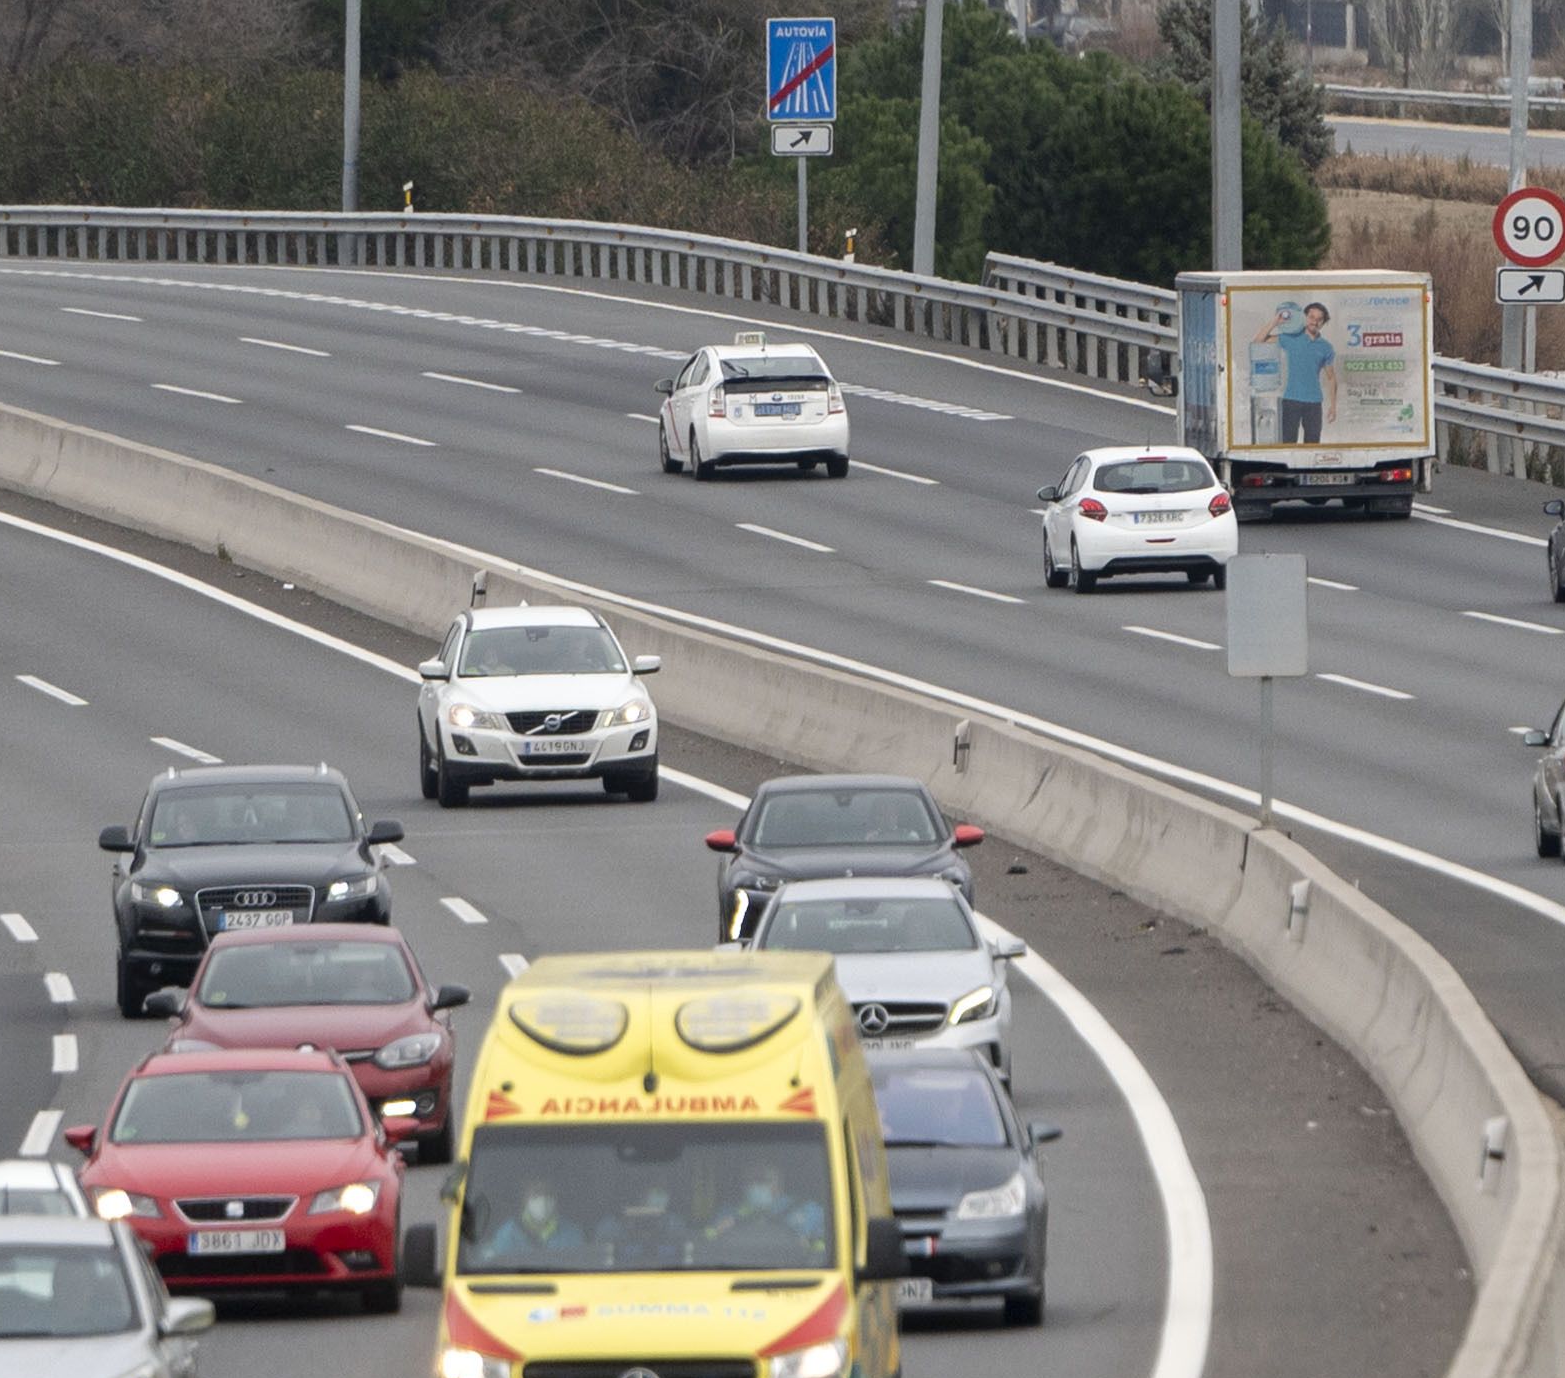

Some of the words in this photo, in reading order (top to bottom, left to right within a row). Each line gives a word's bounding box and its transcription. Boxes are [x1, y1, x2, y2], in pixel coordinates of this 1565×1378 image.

[775, 24, 828, 39] AUTOVÍA
[1512, 214, 1554, 243] 90
[1346, 324, 1362, 347] 3
[1364, 333, 1402, 346] gratis
[227, 912, 262, 927] 2437
